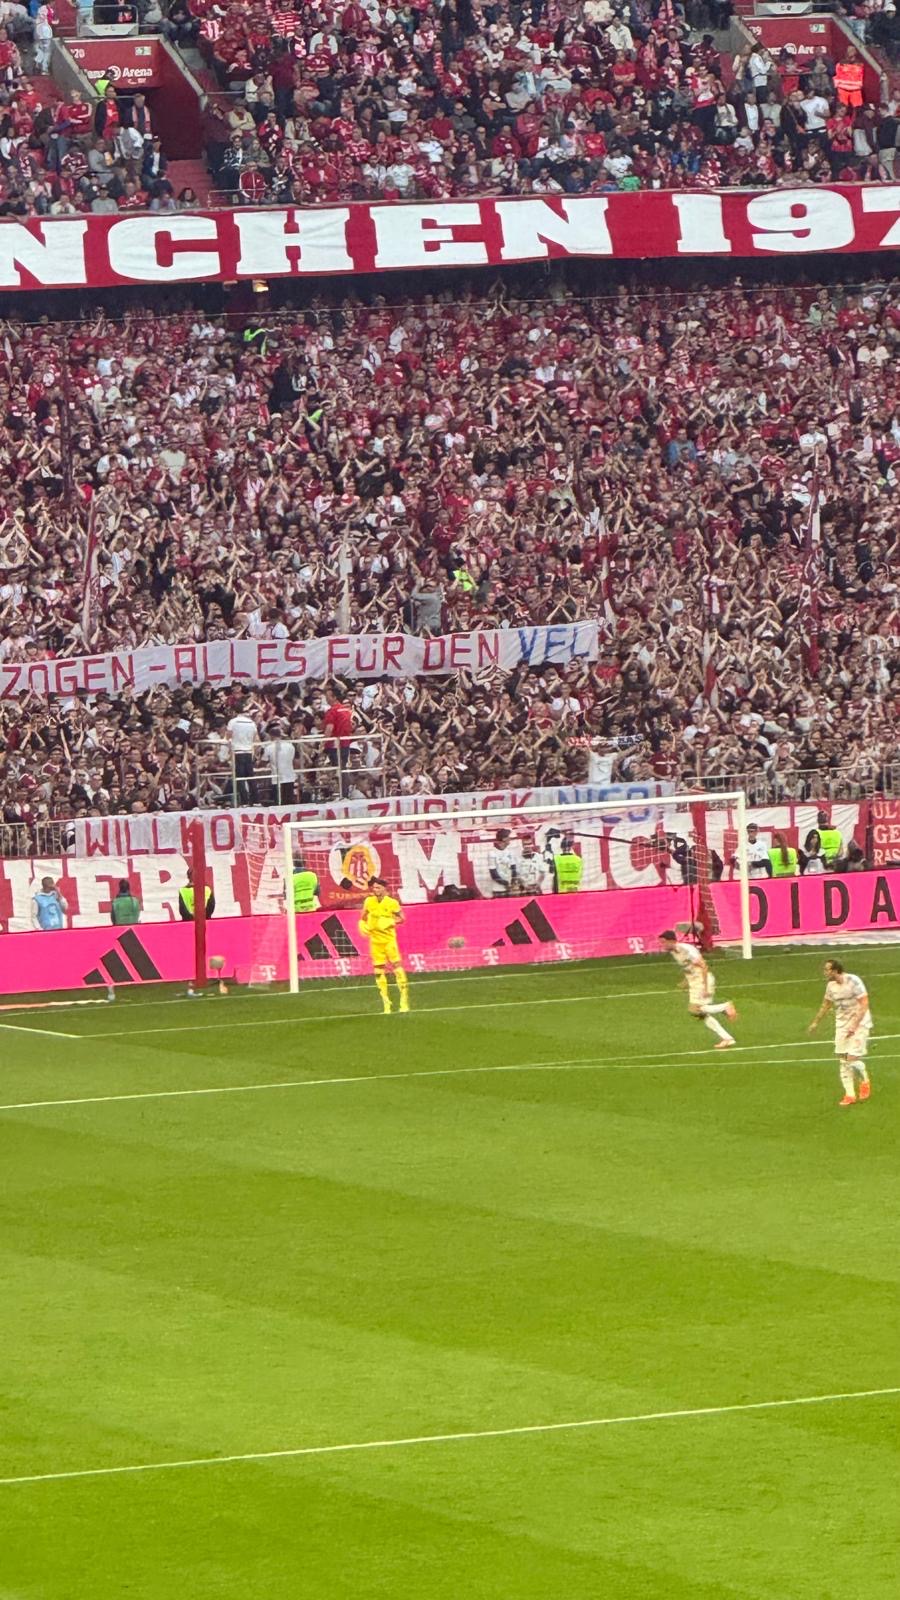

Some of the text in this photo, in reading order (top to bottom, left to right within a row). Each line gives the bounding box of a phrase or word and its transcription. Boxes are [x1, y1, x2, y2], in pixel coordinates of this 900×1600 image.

[122, 67, 153, 77] Arena
[175, 641, 306, 683] ALLES
[328, 635, 404, 673] FÜR
[423, 633, 499, 670] DEN
